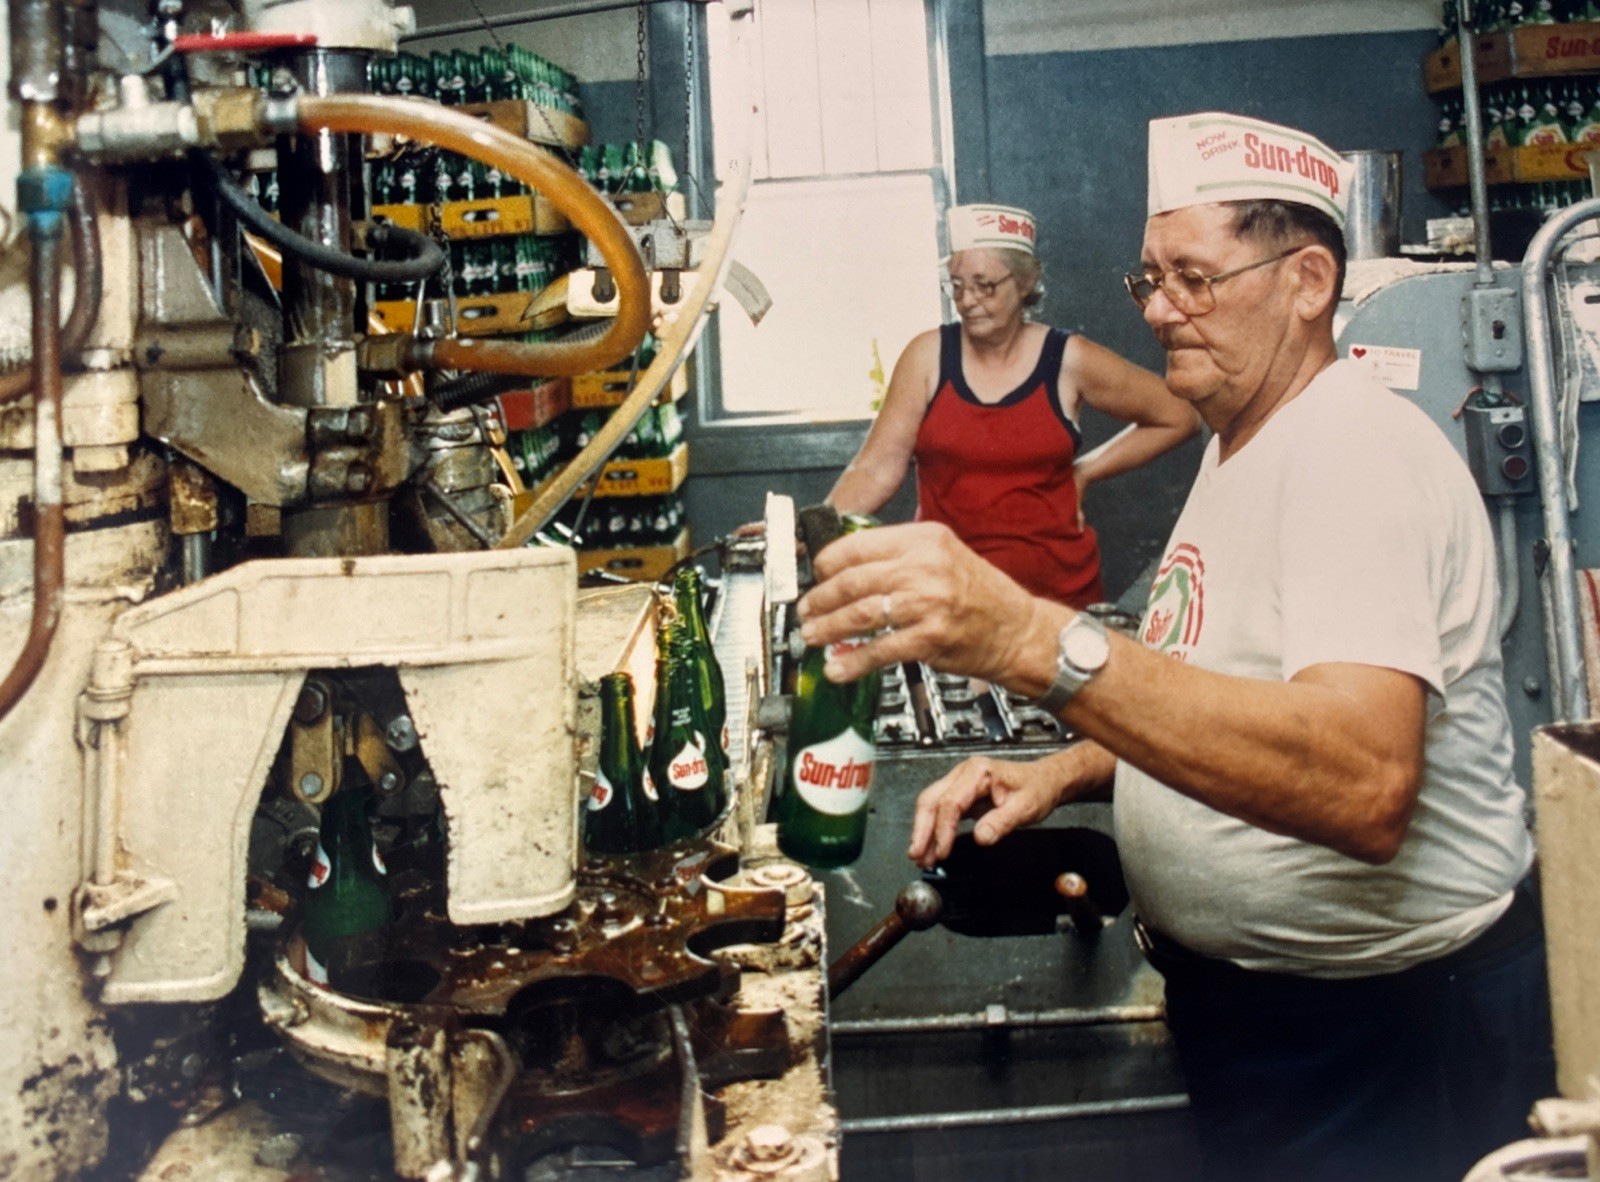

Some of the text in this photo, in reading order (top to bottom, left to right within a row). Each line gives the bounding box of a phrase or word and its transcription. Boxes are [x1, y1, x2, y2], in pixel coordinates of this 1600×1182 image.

[1196, 131, 1226, 151] NOW
[1202, 141, 1241, 161] DRINK
[1244, 133, 1339, 198] Sun-drop
